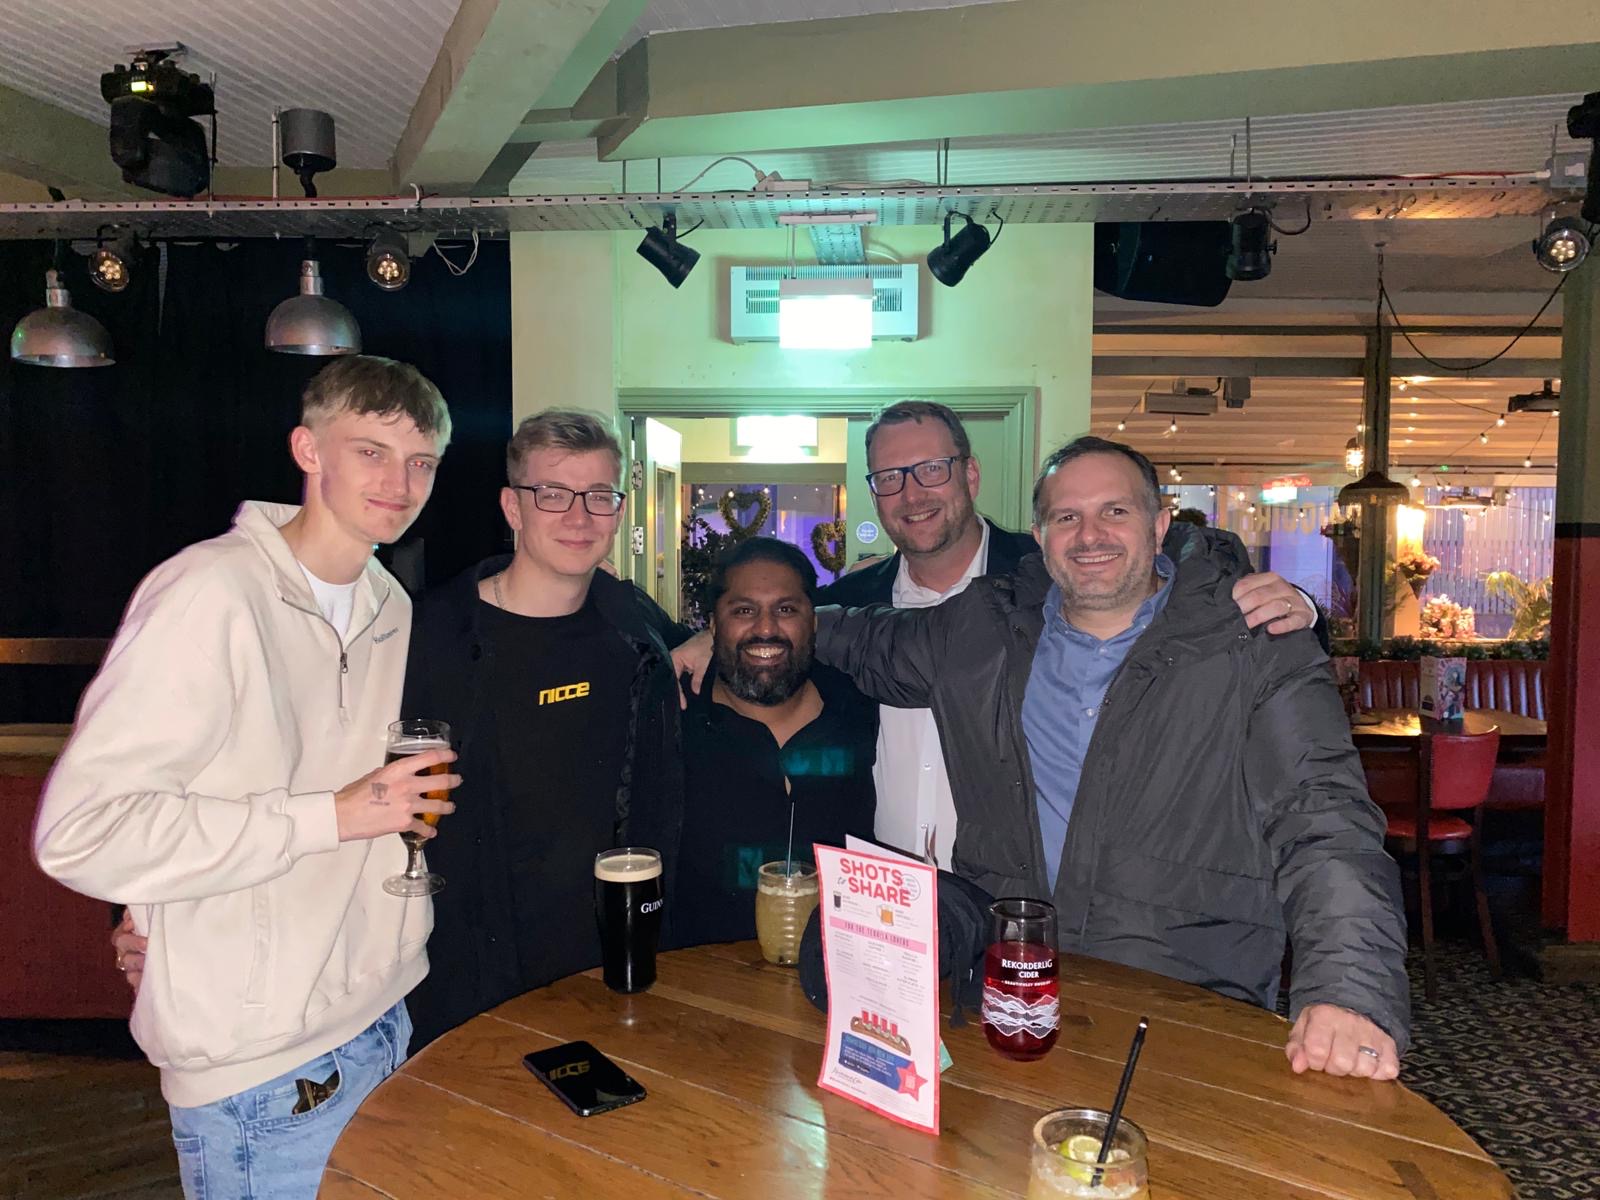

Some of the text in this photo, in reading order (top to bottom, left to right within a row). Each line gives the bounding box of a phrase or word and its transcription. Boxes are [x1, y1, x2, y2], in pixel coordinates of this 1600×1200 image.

[840, 858, 903, 887] SHOTS
[848, 877, 911, 907] SHARE
[1001, 958, 1053, 970] REKORDERLIG
[1018, 971, 1040, 979] CIDER
